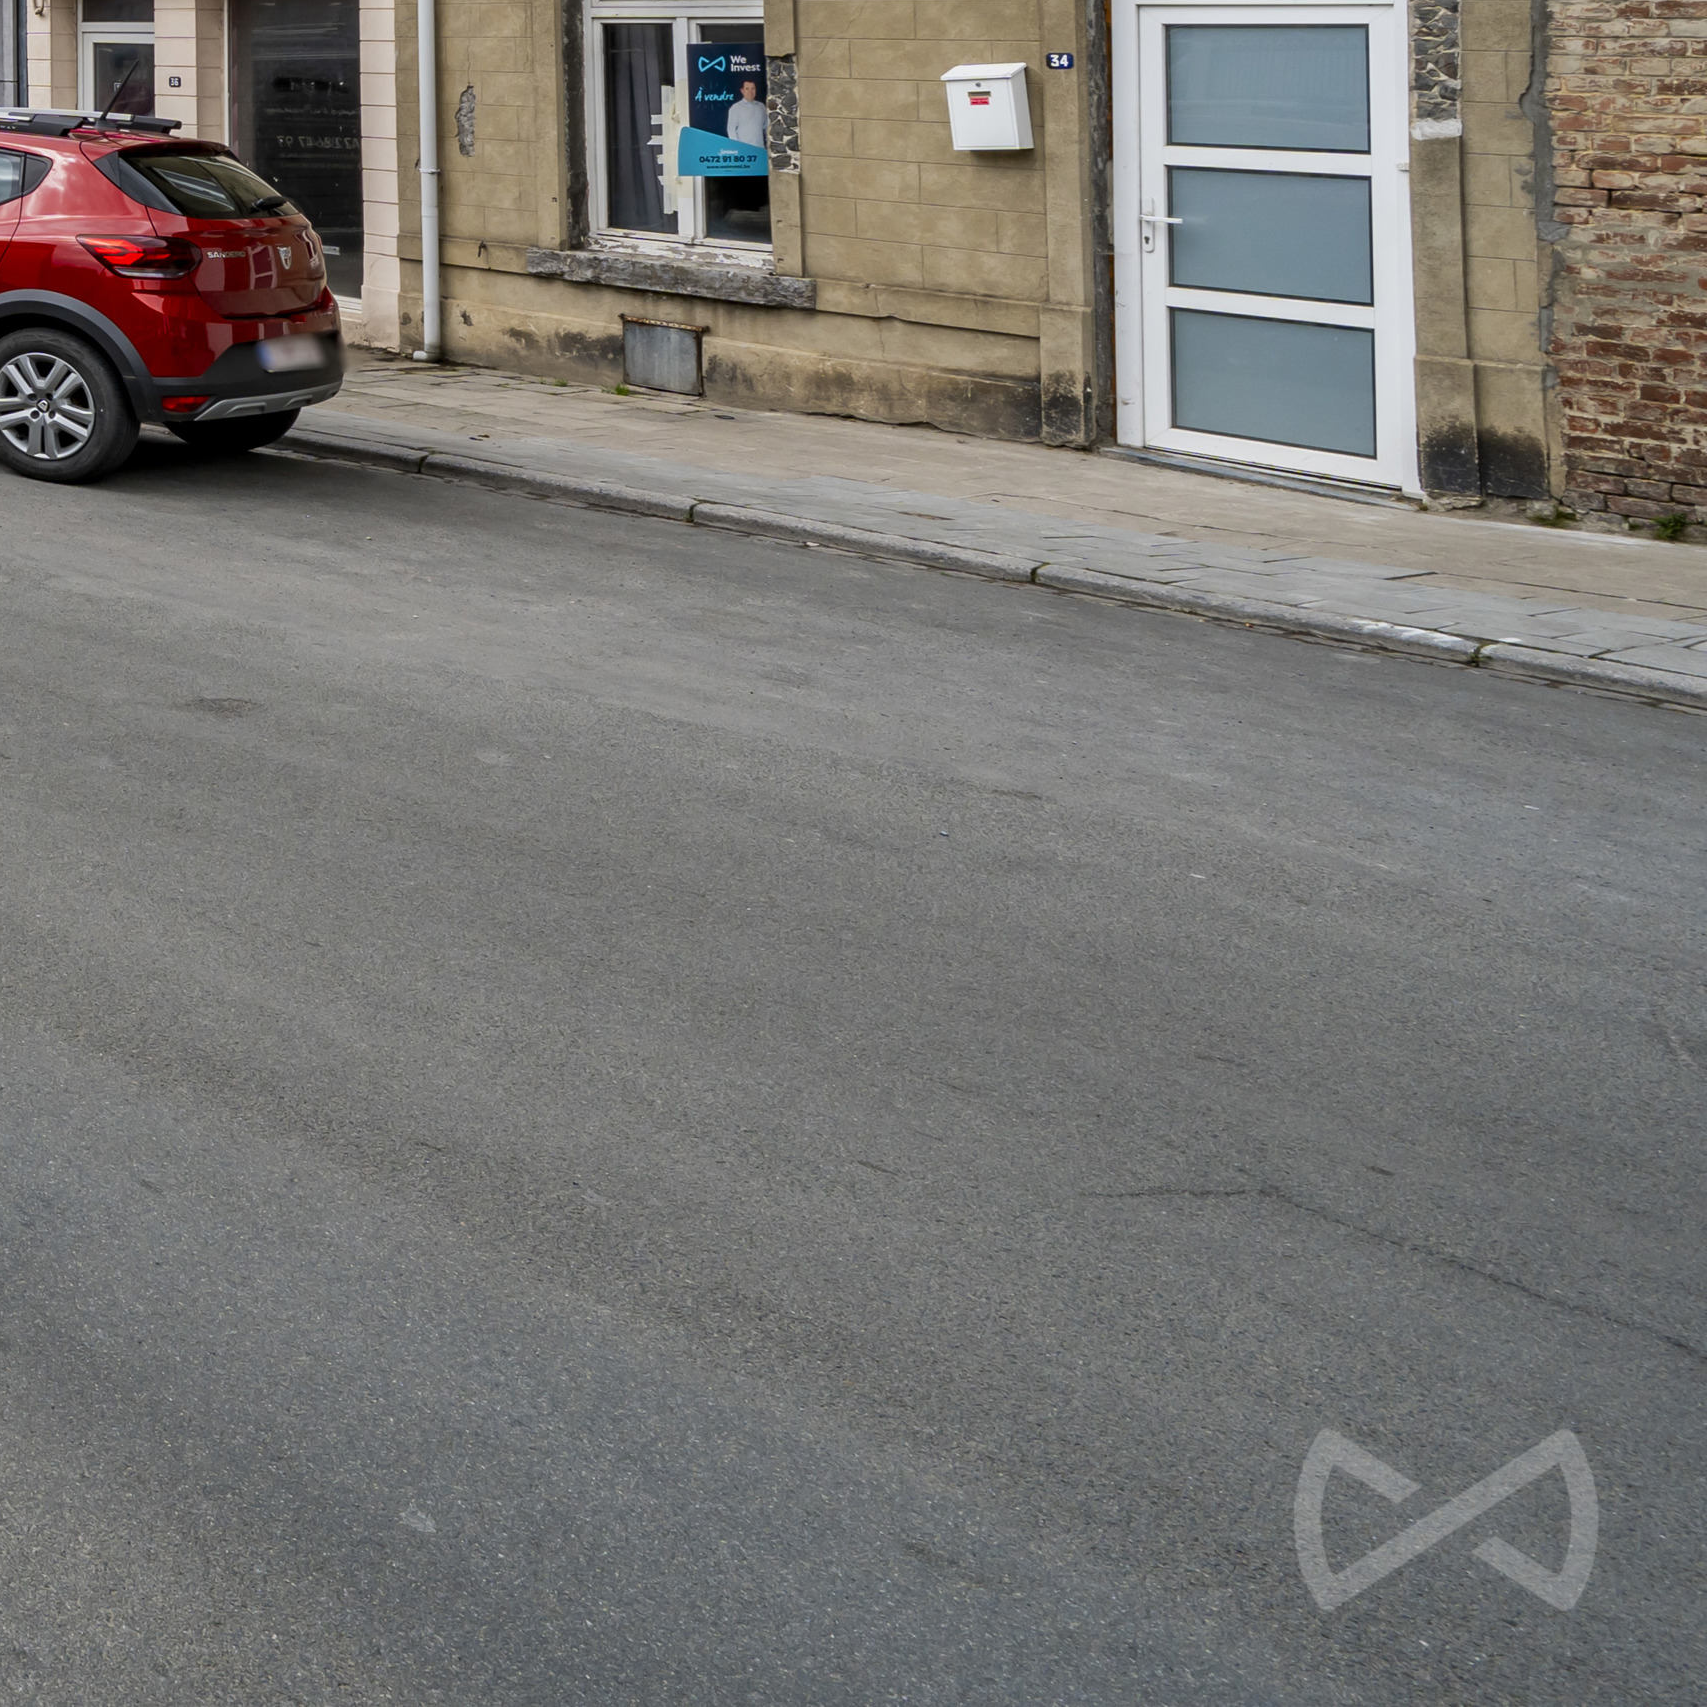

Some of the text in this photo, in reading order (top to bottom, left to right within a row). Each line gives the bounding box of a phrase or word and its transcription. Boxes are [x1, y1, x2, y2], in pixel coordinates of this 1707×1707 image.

[730, 55, 747, 64] We
[1050, 54, 1069, 67] 34
[730, 64, 761, 72] Invest
[170, 77, 179, 86] 36
[695, 87, 734, 102] À vendre
[206, 250, 246, 259] SANDERO
